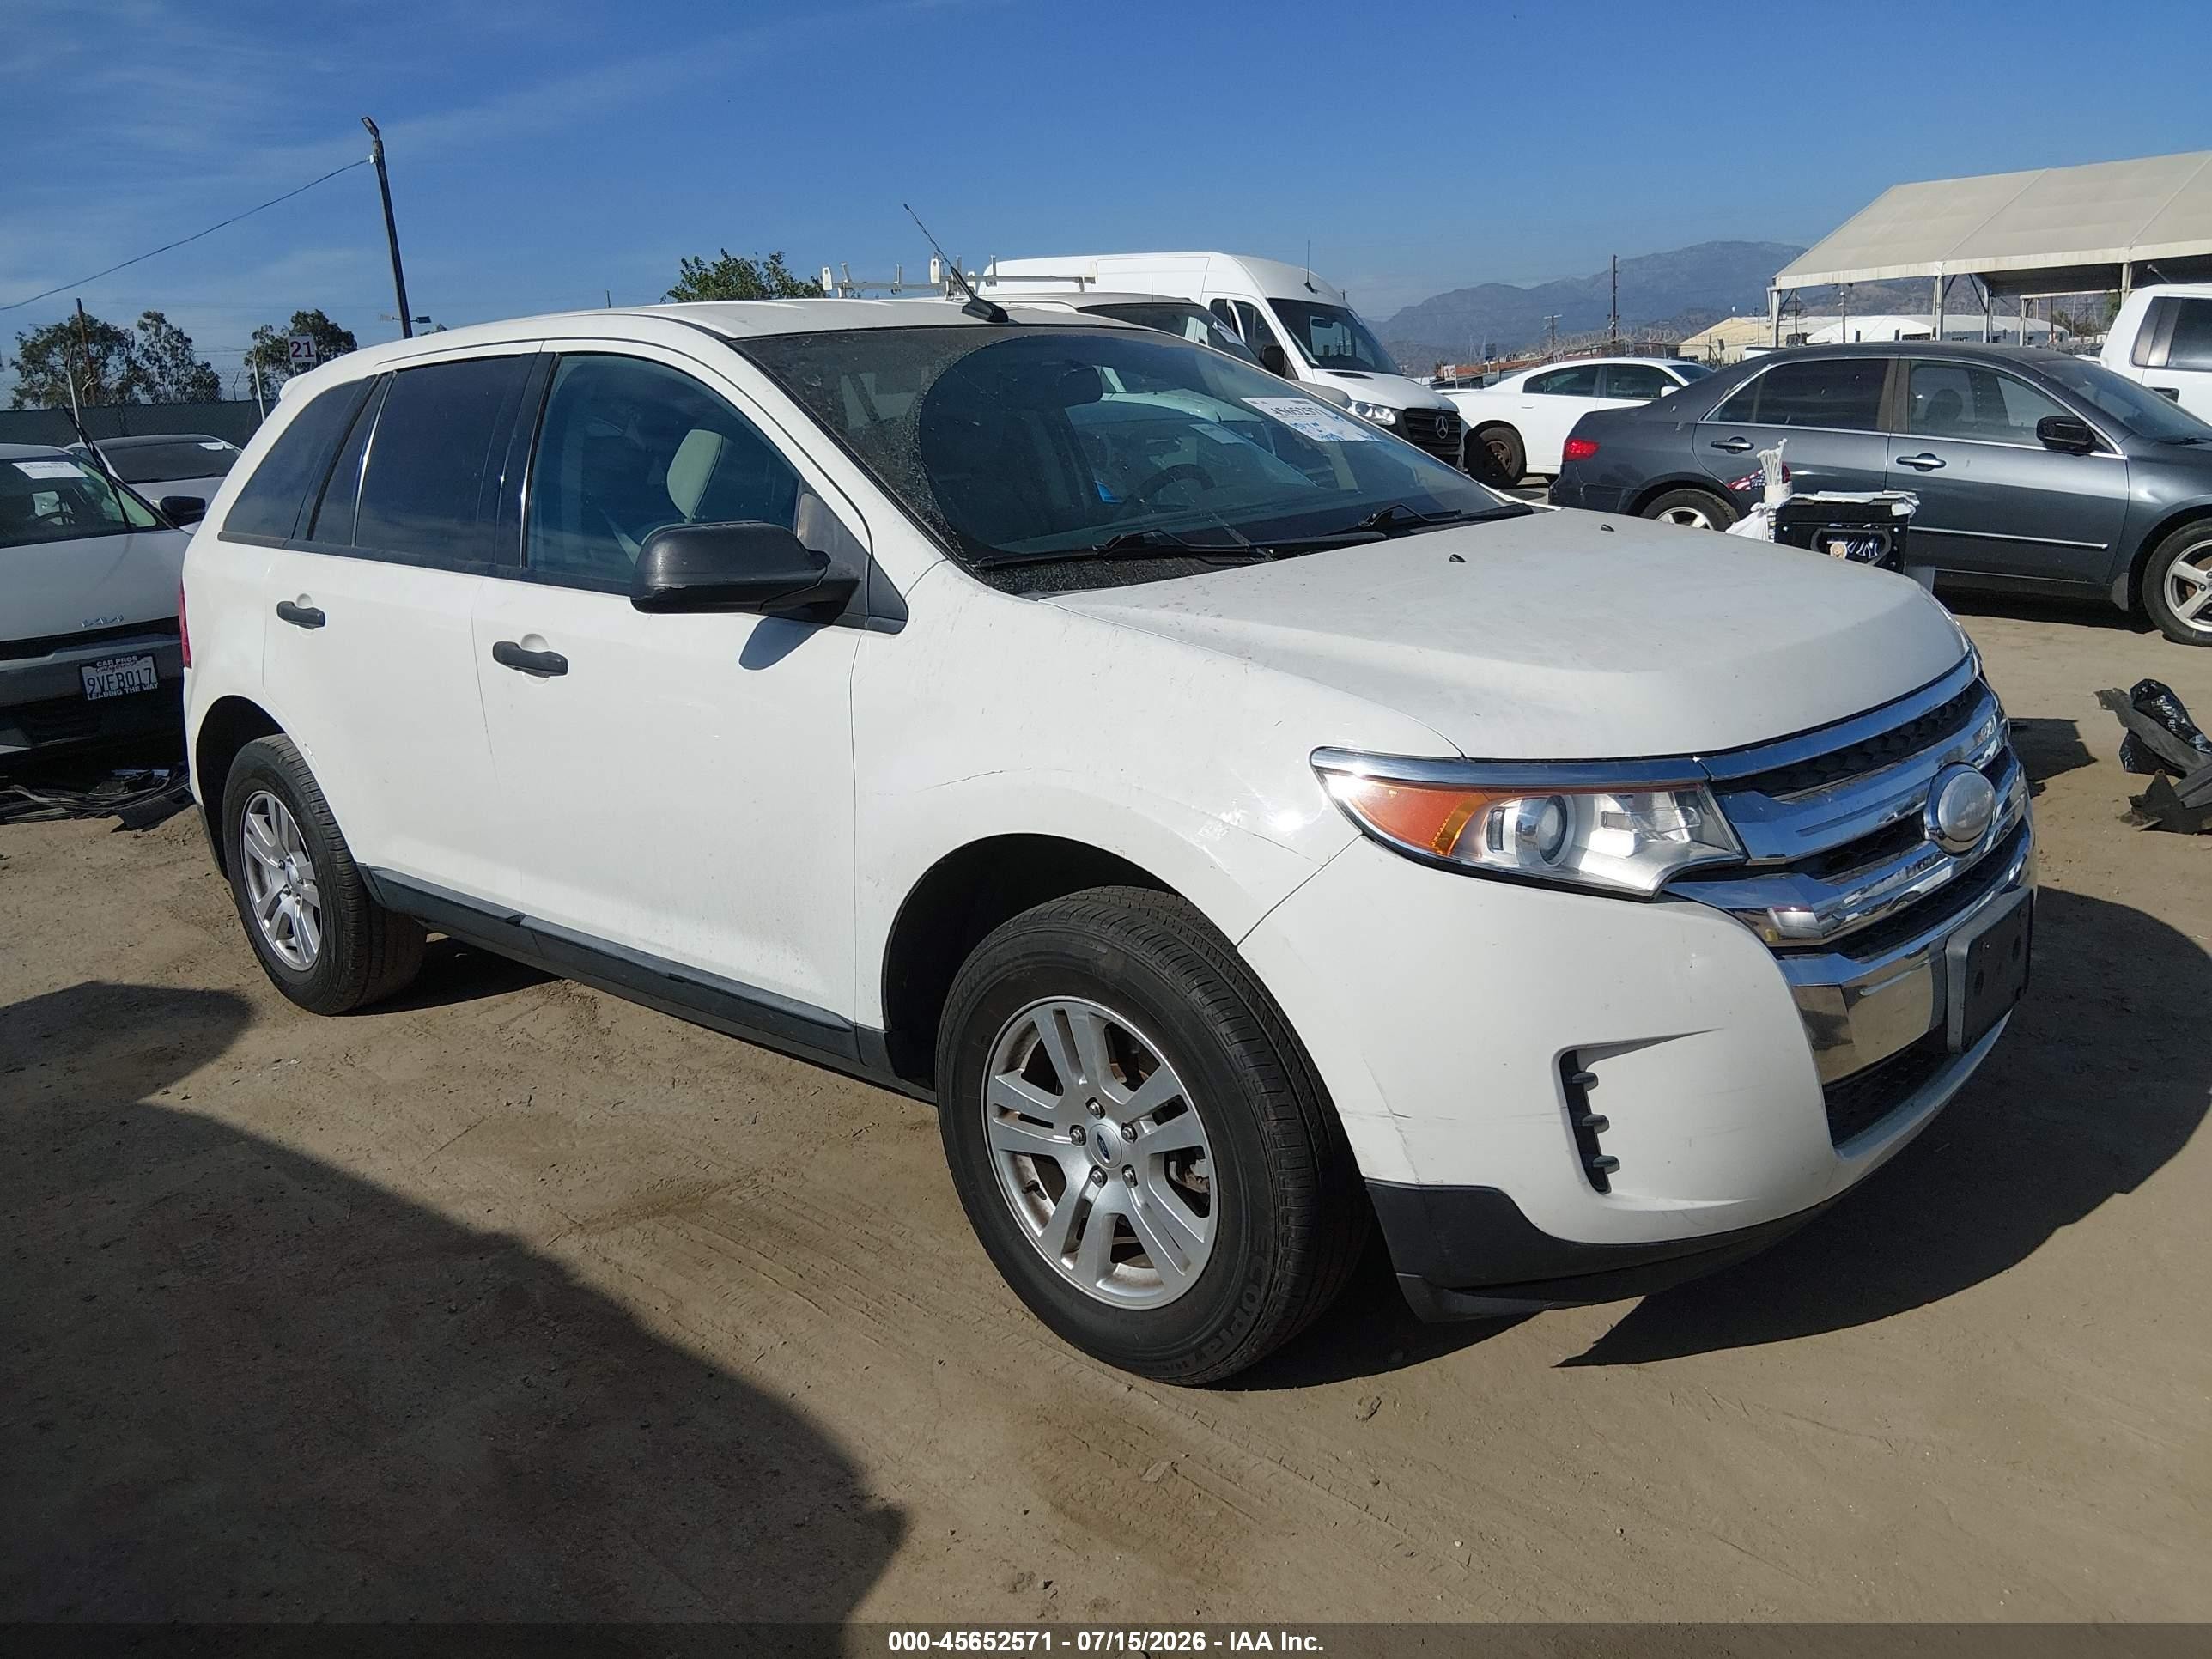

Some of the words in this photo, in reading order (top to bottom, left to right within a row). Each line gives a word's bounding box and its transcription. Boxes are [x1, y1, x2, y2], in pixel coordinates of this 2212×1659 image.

[290, 341, 315, 358] 21
[1444, 368, 1455, 378] 13
[96, 659, 113, 668] CAR
[115, 655, 138, 665] PROS
[87, 667, 152, 697] 9VFB017
[124, 685, 141, 695] THE
